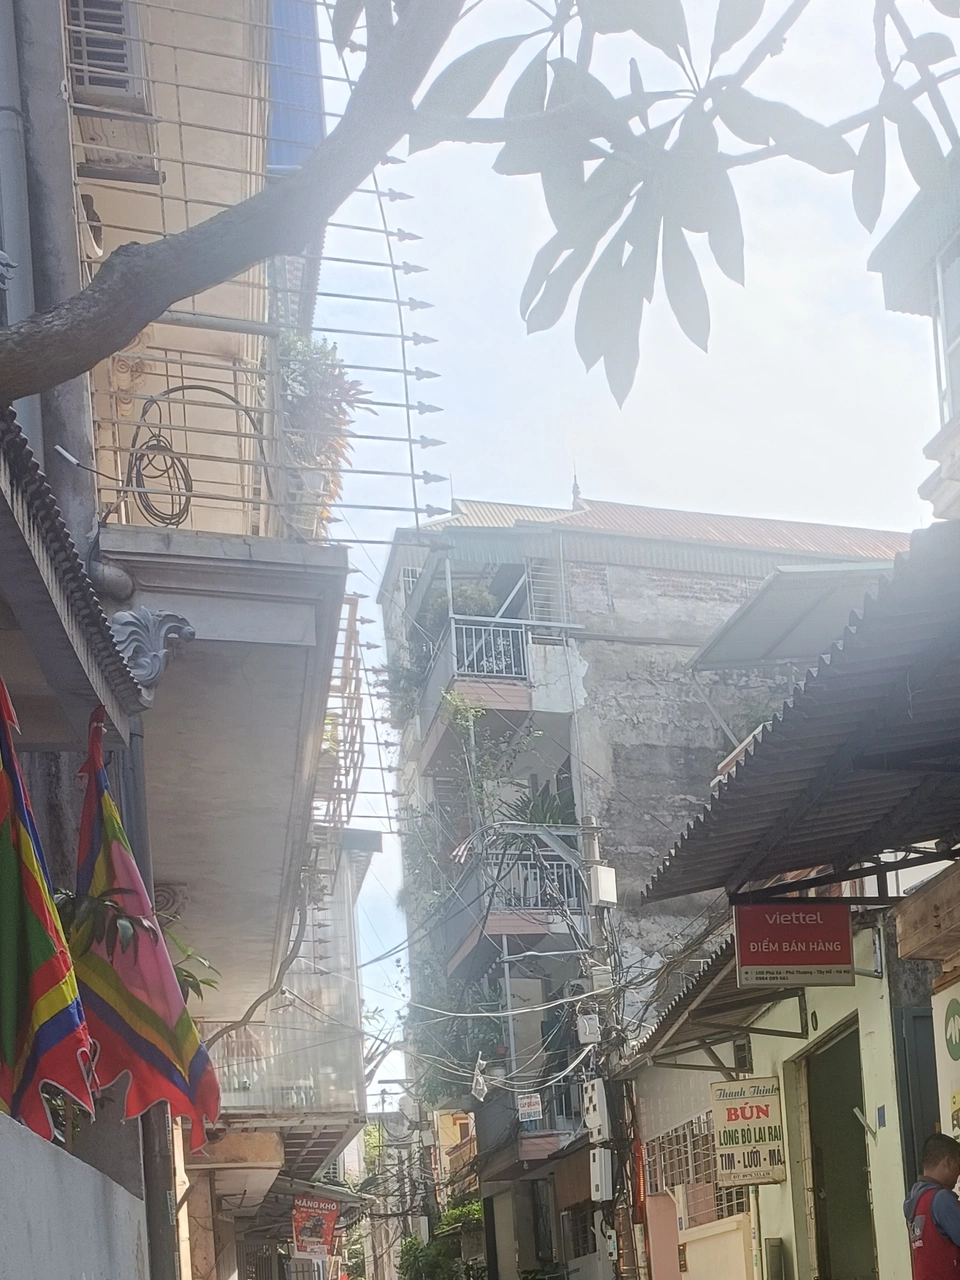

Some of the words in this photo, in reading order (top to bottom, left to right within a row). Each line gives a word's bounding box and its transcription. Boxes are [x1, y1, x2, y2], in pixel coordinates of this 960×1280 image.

[765, 911, 824, 925] viettel
[749, 938, 779, 952] ĐIỂM
[782, 940, 806, 952] BÁN
[809, 939, 842, 952] HÀNG
[715, 1087, 746, 1099] Thanh
[725, 1102, 770, 1122] BÚN
[719, 1126, 740, 1147] LÒNG
[740, 1124, 752, 1145] BÒ
[753, 1126, 767, 1143] LAI
[767, 1125, 782, 1142] RAI
[719, 1152, 736, 1171] TIM
[742, 1146, 762, 1169] LƯỠI
[768, 1145, 783, 1167] MÁ
[320, 1202, 337, 1210] KHÔ
